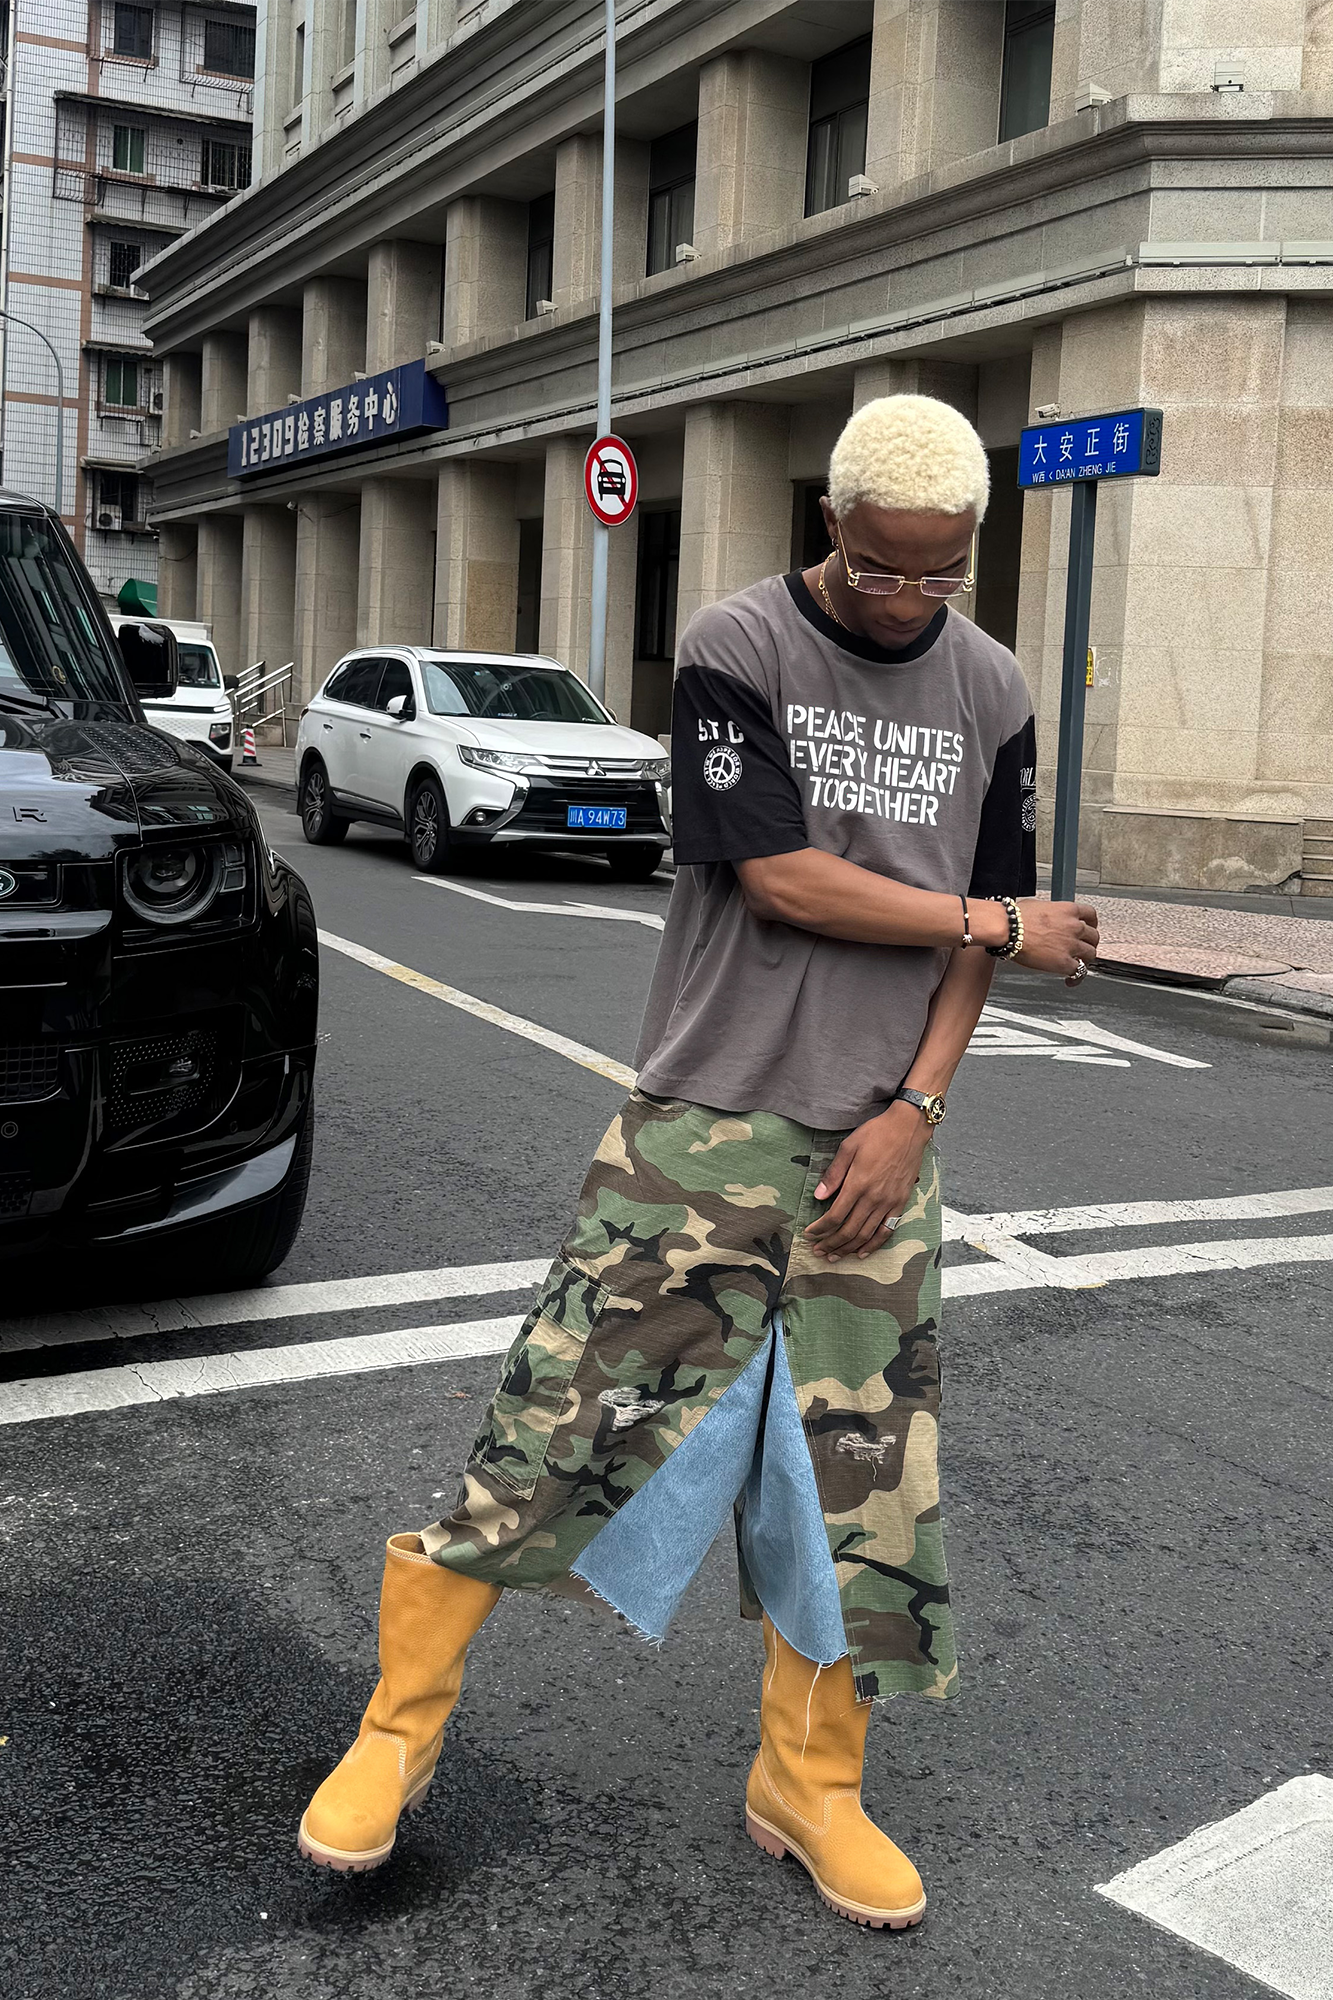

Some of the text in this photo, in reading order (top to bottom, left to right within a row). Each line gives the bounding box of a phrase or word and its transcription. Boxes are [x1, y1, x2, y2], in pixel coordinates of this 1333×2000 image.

[241, 381, 398, 467] 12309检察服务中心
[1033, 422, 1130, 465] 大安正街
[1078, 463, 1103, 477] ZHENG
[1105, 461, 1117, 473] JIE
[787, 704, 965, 762] PEACE UNITES
[790, 739, 961, 795] EVERY HEART
[809, 775, 939, 826] TOGETHER
